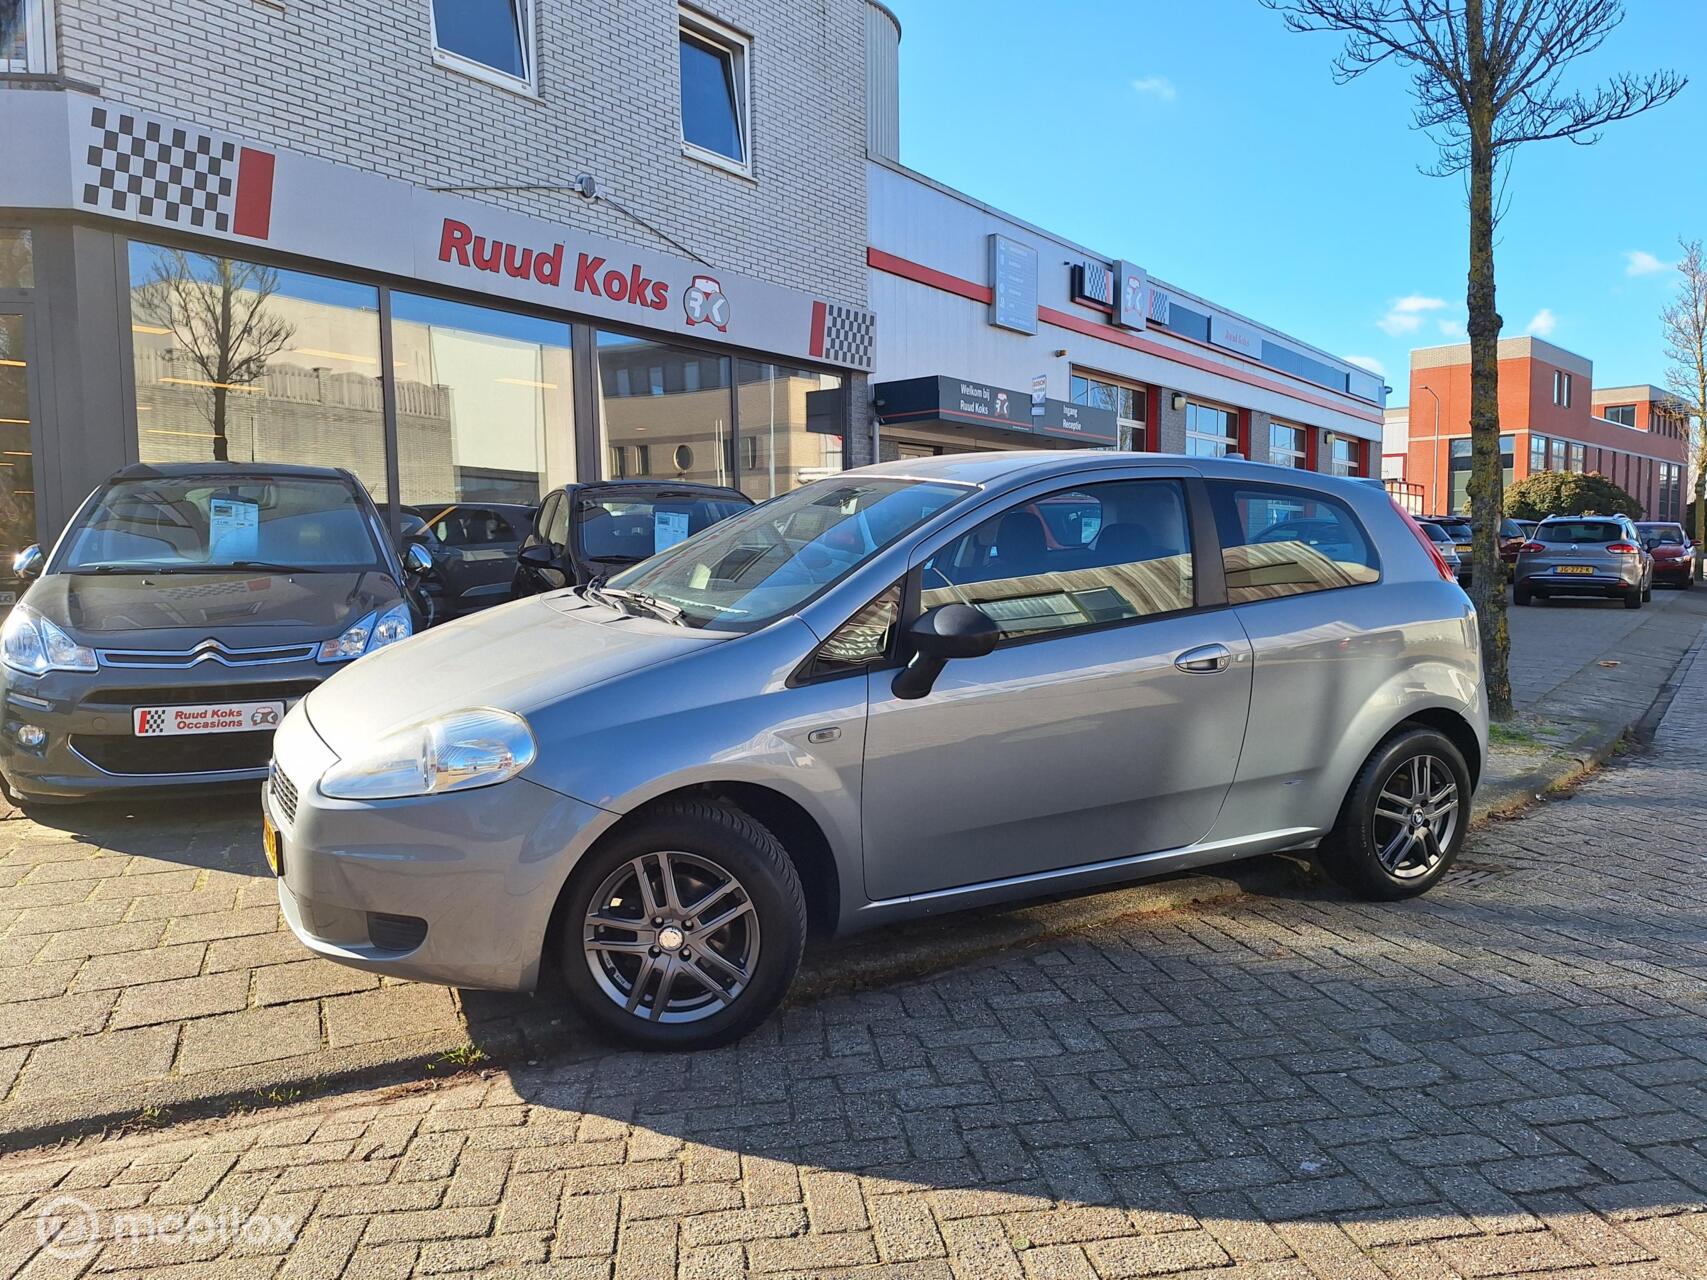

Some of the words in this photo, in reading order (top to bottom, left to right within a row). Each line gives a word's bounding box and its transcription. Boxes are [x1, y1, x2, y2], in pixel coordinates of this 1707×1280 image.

[438, 217, 564, 287] Ruud
[574, 252, 670, 311] Koks
[960, 383, 983, 398] Welkom
[982, 387, 991, 402] bij
[960, 399, 975, 413] Ruud
[974, 402, 989, 415] Koks
[1063, 404, 1078, 418] Ingang
[1062, 418, 1082, 432] Receptie
[174, 709, 208, 720] Ruud
[210, 708, 243, 719] Koks
[176, 719, 243, 730] Occasions
